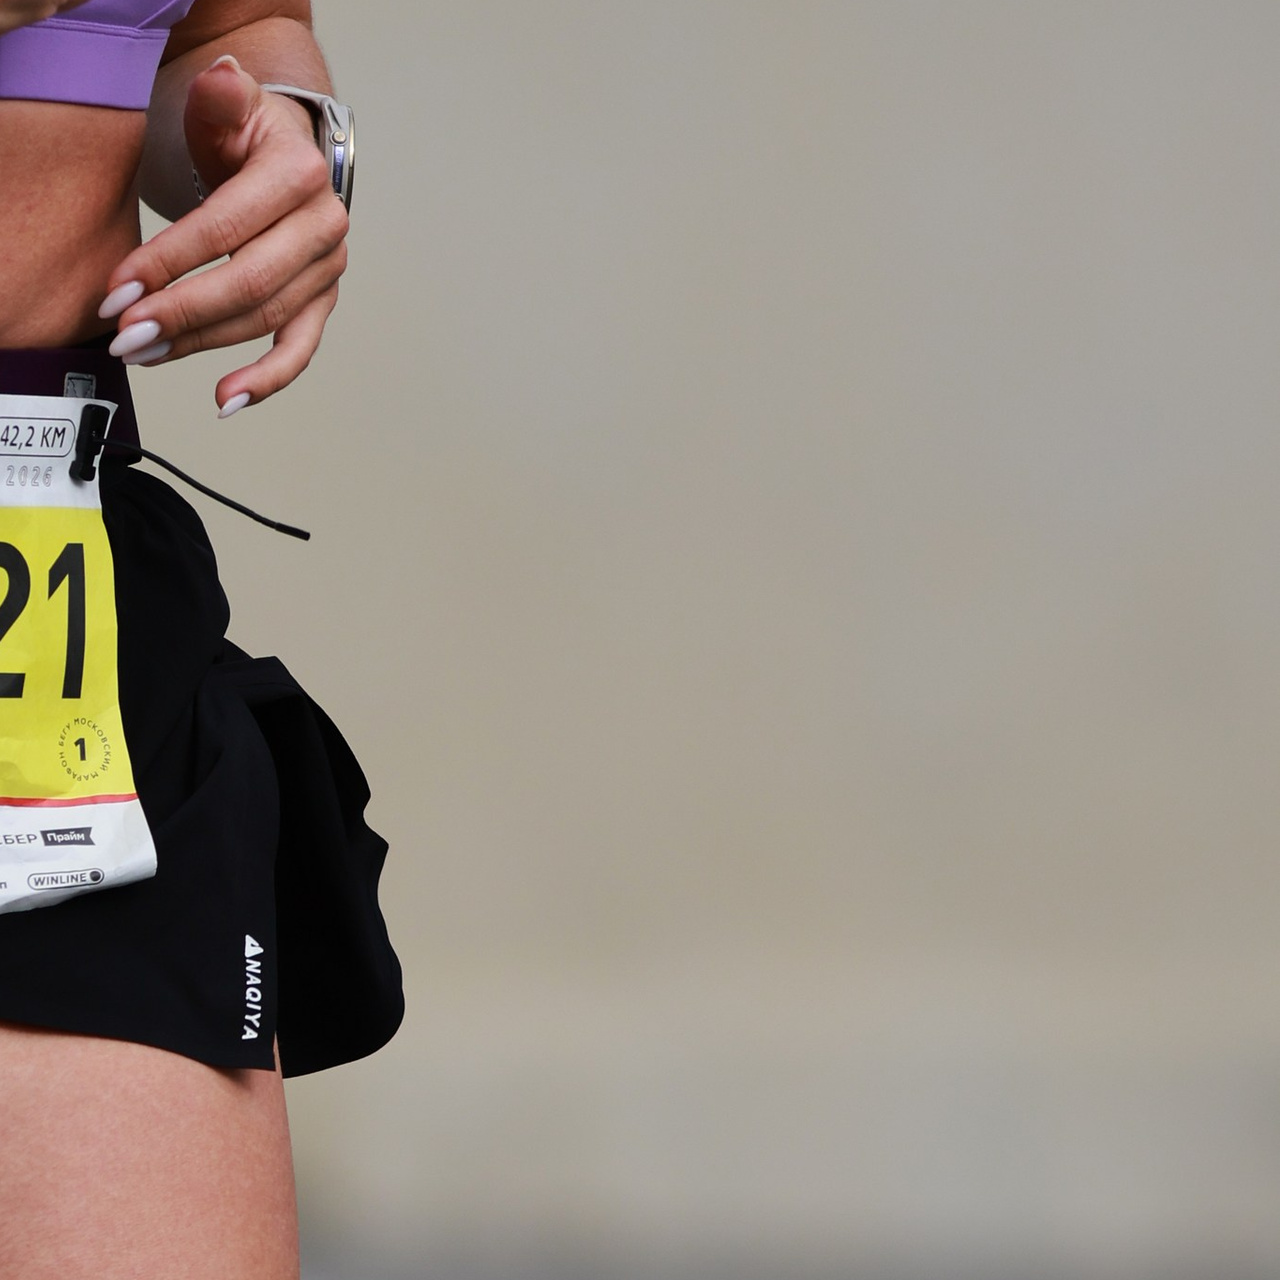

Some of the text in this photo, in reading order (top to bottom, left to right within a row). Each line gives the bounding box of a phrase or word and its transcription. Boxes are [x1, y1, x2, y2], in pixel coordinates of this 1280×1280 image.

[0, 425, 35, 450] 42,2
[5, 465, 53, 487] 2026
[74, 737, 87, 762] 1
[46, 830, 86, 843] Прайм
[33, 872, 88, 887] WINLINE
